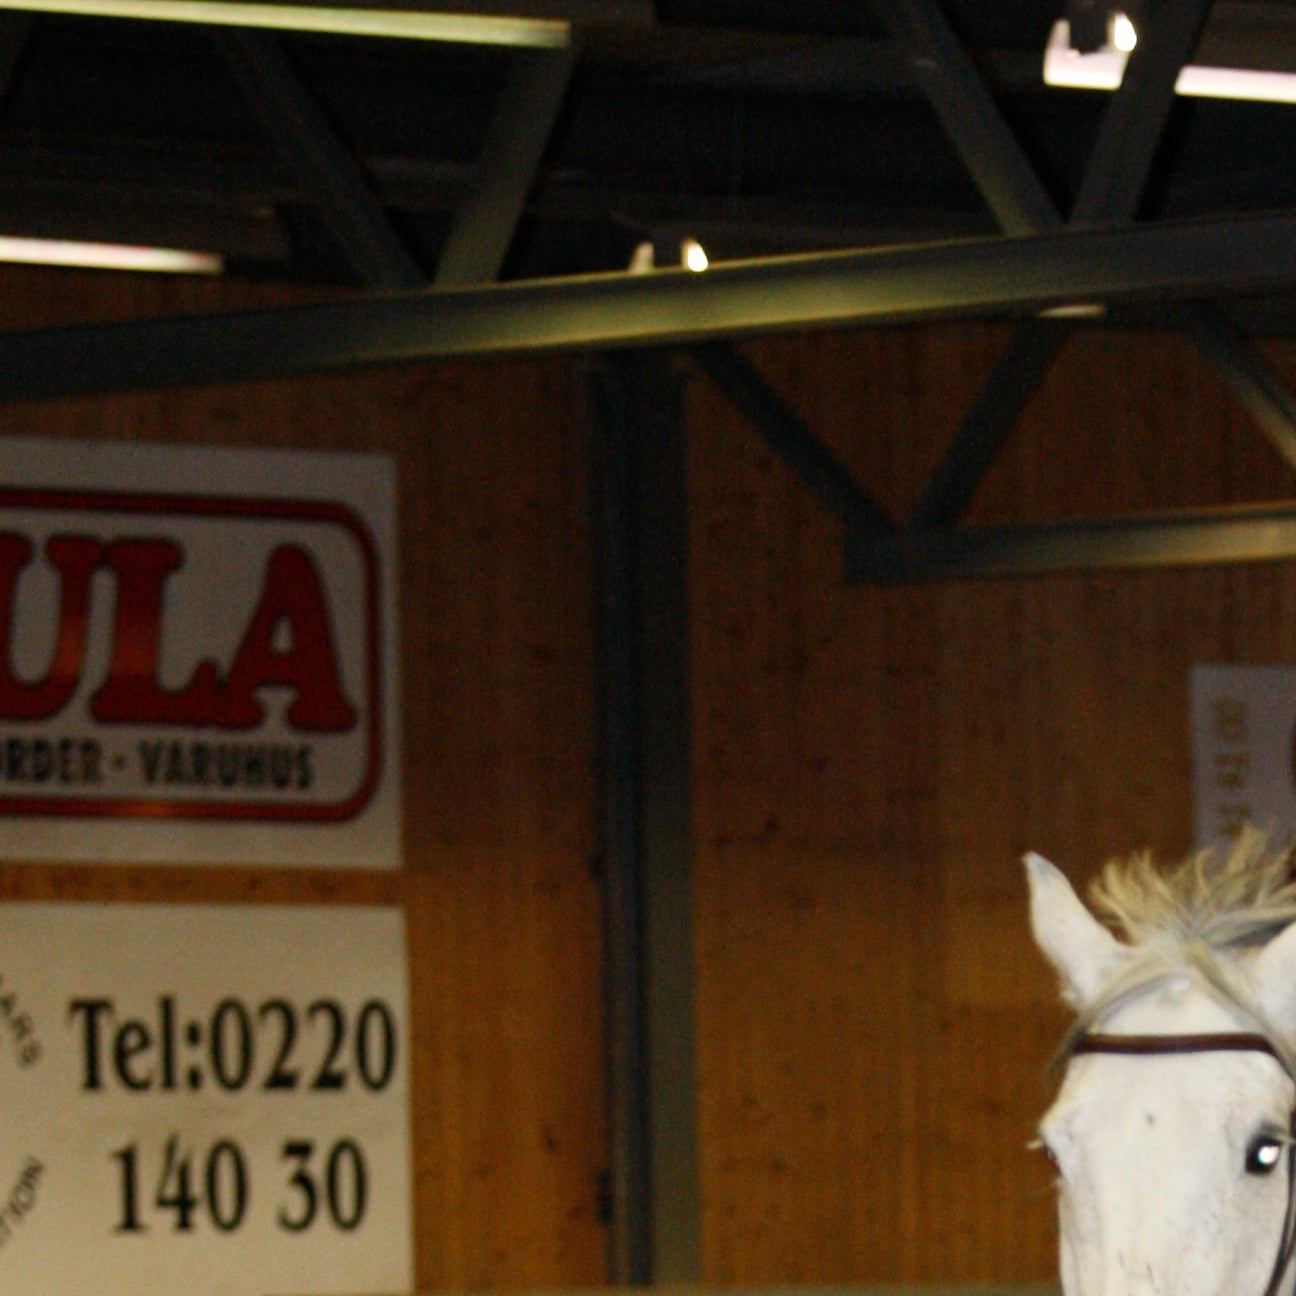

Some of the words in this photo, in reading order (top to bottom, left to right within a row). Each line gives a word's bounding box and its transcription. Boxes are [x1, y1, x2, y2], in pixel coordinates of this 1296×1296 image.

[0, 738, 103, 784] RDER
[138, 740, 314, 790] VARUHUS
[69, 994, 396, 1092] Tel:0220
[109, 1130, 249, 1236] 140
[277, 1137, 369, 1233] 30
